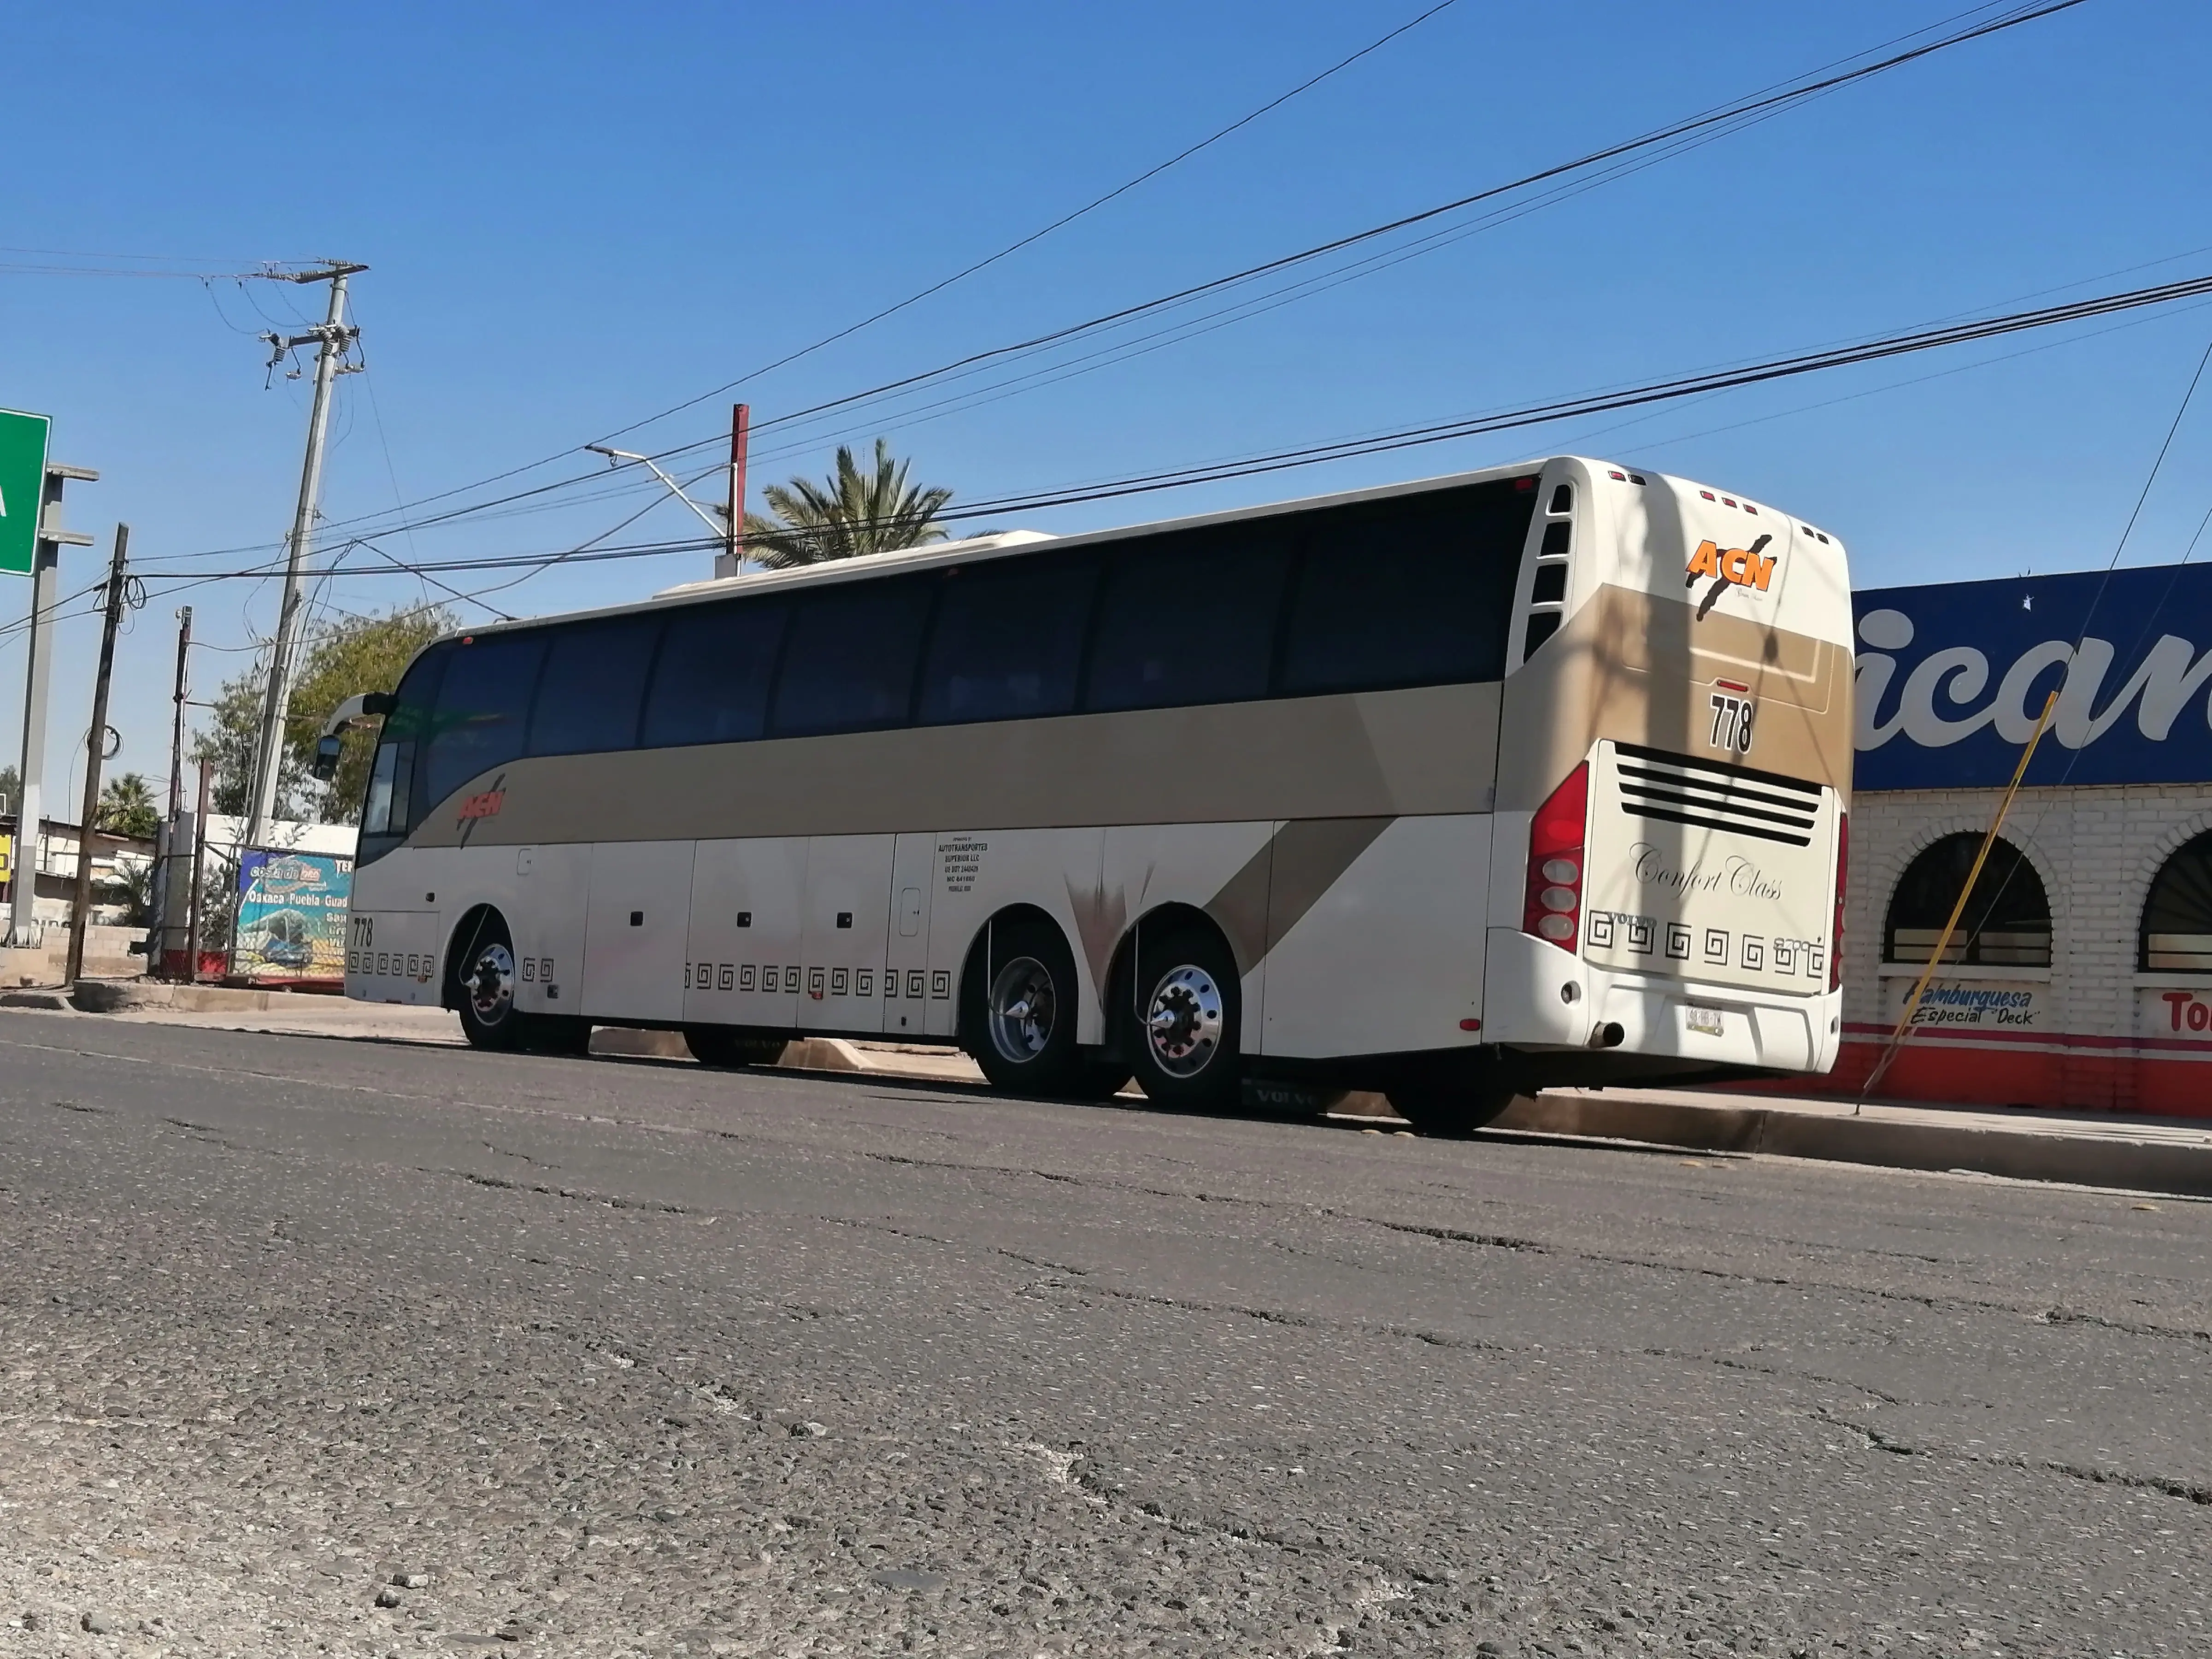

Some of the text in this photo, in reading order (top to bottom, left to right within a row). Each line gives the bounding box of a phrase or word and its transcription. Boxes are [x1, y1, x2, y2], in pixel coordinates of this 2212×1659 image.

[1685, 539, 1774, 592] ACN
[1710, 692, 1753, 754] 778
[1629, 842, 1782, 900] Confort Class
[249, 890, 348, 907] Oaxaca Puebla Guad
[354, 917, 373, 947] 778
[1607, 912, 1657, 928] VOLVO
[1911, 1006, 1982, 1025] Especial
[2162, 992, 2212, 1032] To
